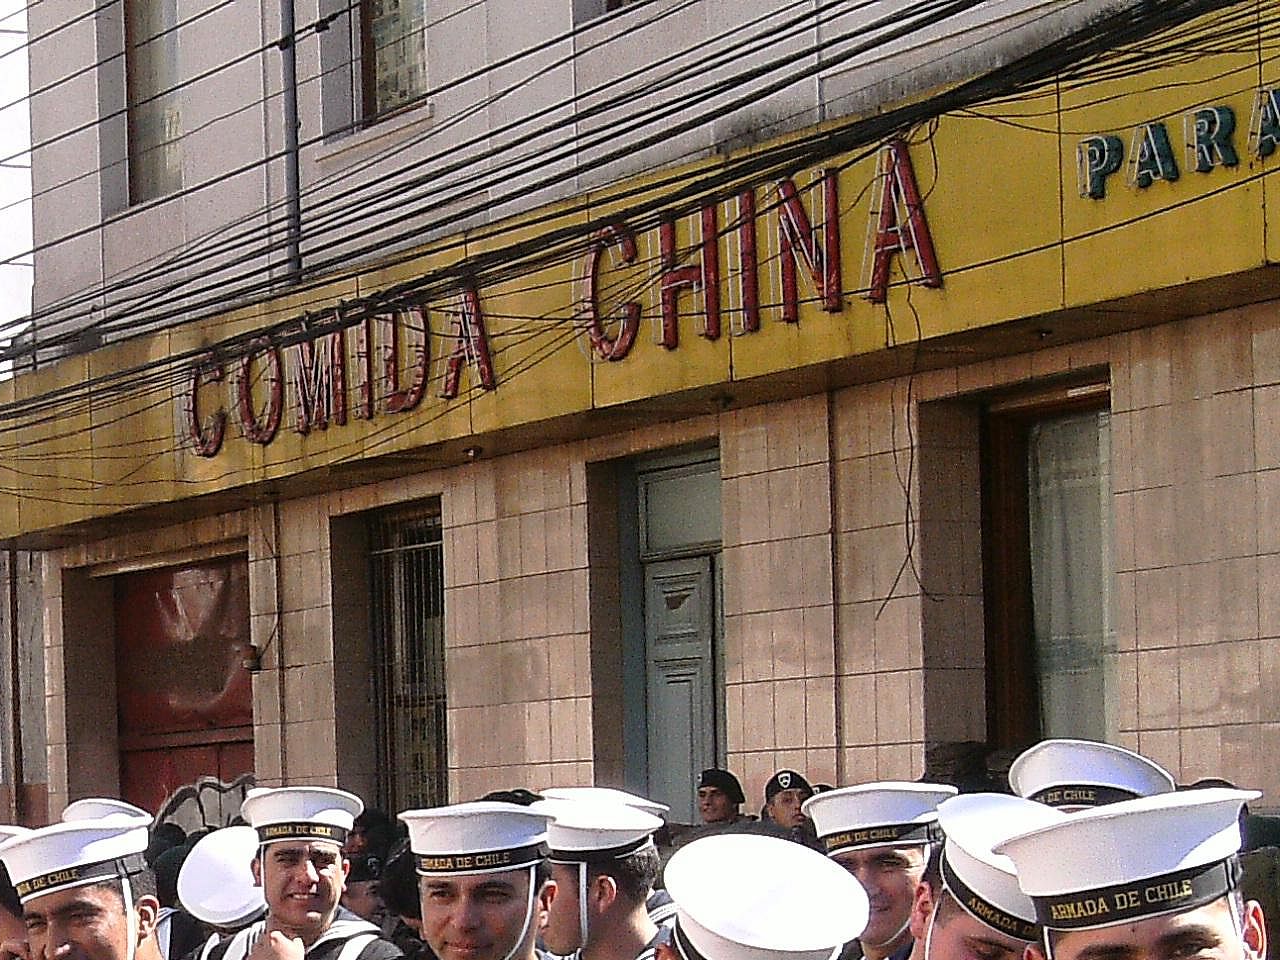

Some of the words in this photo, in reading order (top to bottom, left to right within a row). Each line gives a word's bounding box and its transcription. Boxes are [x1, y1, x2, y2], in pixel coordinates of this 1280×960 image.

[1077, 88, 1280, 199] PARA
[182, 290, 496, 457] COMIDA
[580, 140, 943, 361] CHINA
[1047, 791, 1061, 802] DE
[1063, 789, 1096, 801] CHILE
[48, 868, 79, 885] CHILE
[456, 856, 473, 868] DE
[475, 852, 511, 867] CHILE
[967, 897, 1018, 932] ARMADA
[1050, 896, 1110, 920] ARMADA
[1114, 889, 1141, 910] DE
[1145, 878, 1194, 904] CHILE
